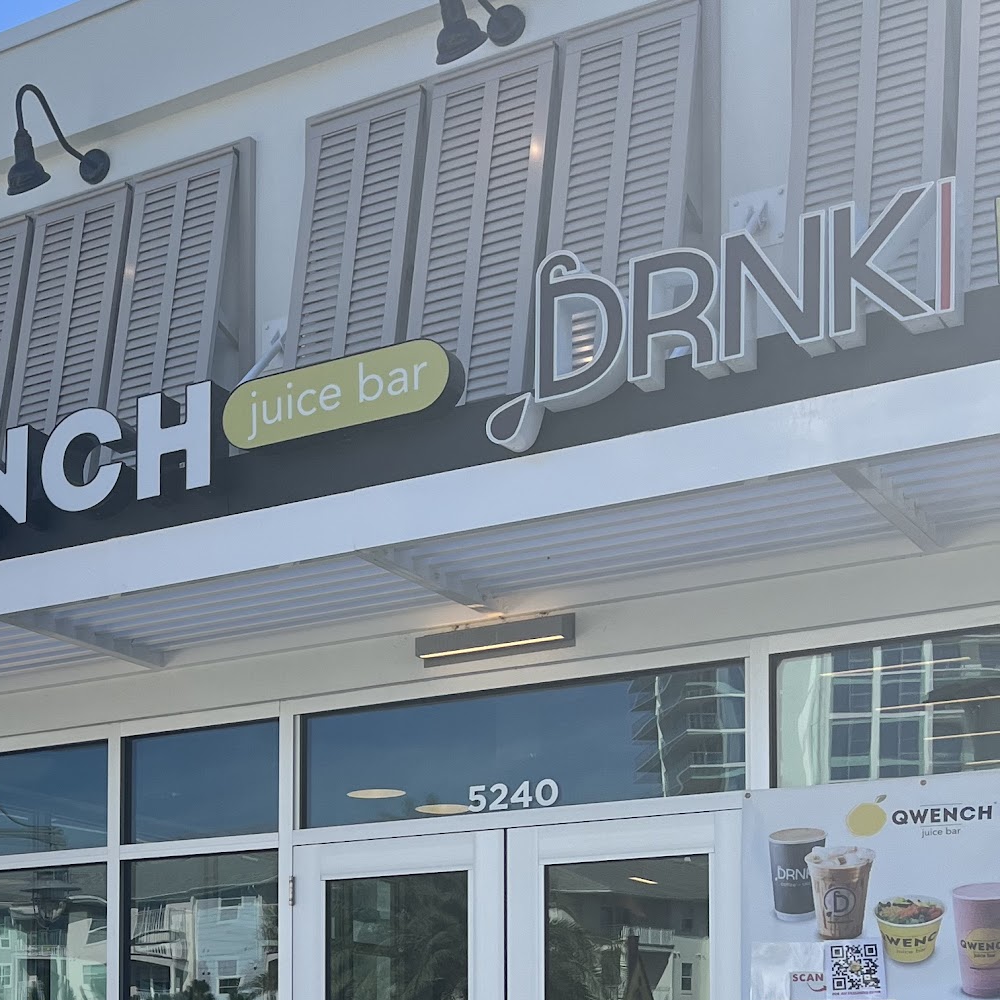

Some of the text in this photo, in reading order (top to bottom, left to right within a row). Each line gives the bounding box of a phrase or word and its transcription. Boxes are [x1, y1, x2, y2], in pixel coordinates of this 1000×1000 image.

[486, 181, 935, 445] DRNK
[247, 357, 429, 441] juice bar
[467, 778, 559, 813] 5240
[892, 805, 993, 825] QWENCH
[922, 827, 961, 838] juice bar
[792, 973, 824, 982] SCAN
